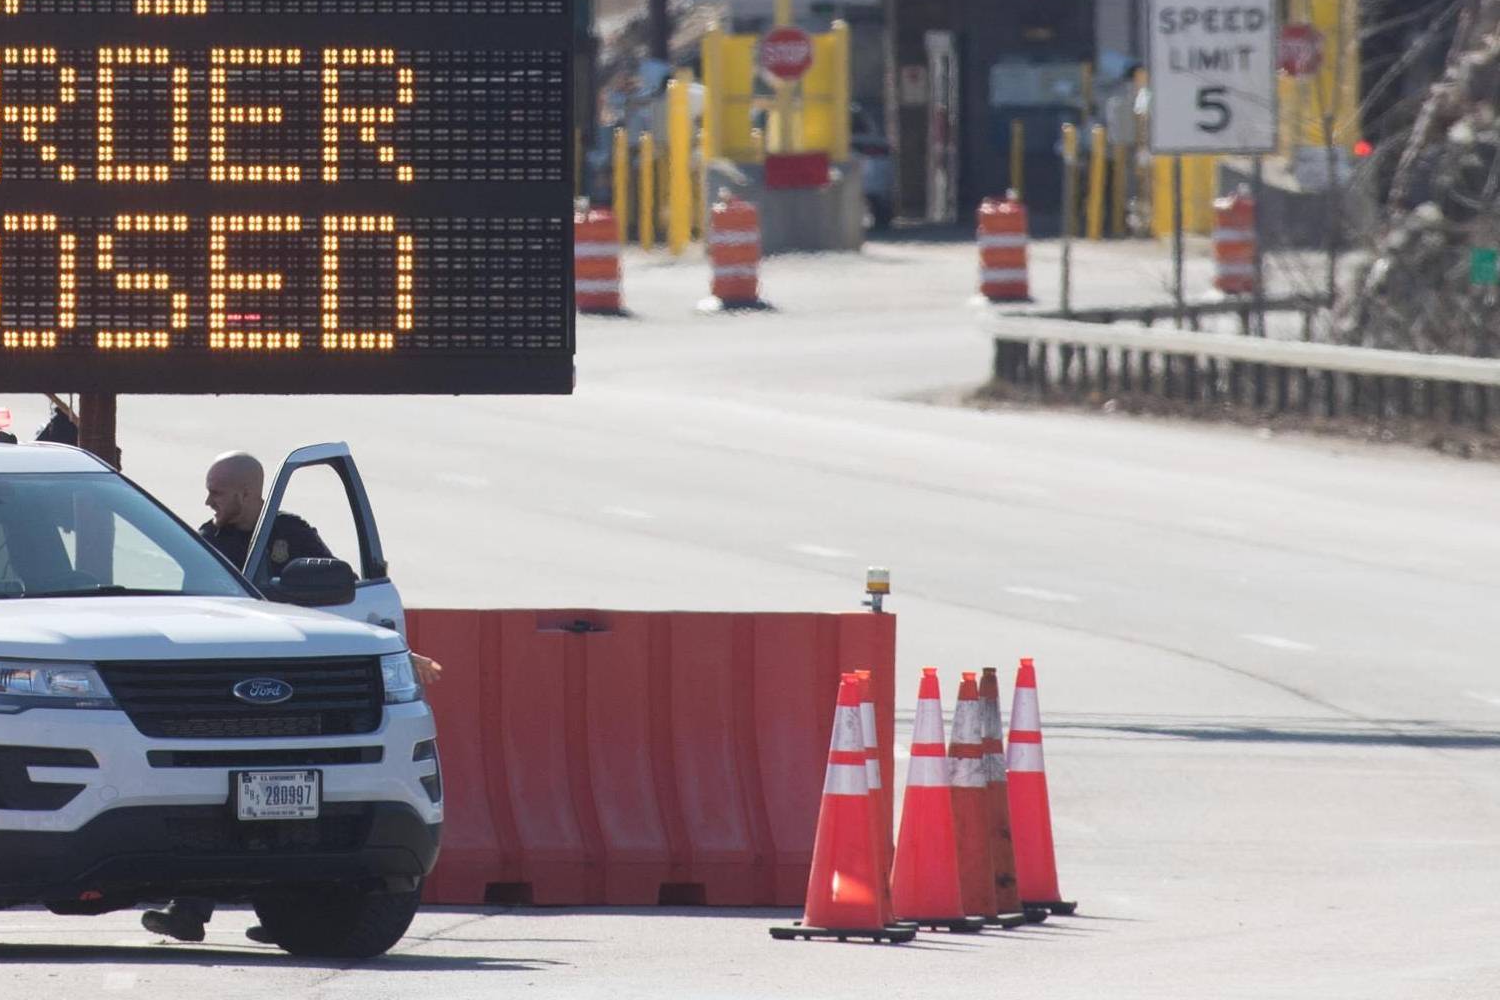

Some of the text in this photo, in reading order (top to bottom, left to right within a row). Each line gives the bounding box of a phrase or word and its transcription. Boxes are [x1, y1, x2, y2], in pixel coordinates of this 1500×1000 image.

[1159, 6, 1266, 35] SPEED
[1168, 45, 1256, 74] LIMIT
[1196, 85, 1232, 133] 5
[249, 680, 281, 696] Ford
